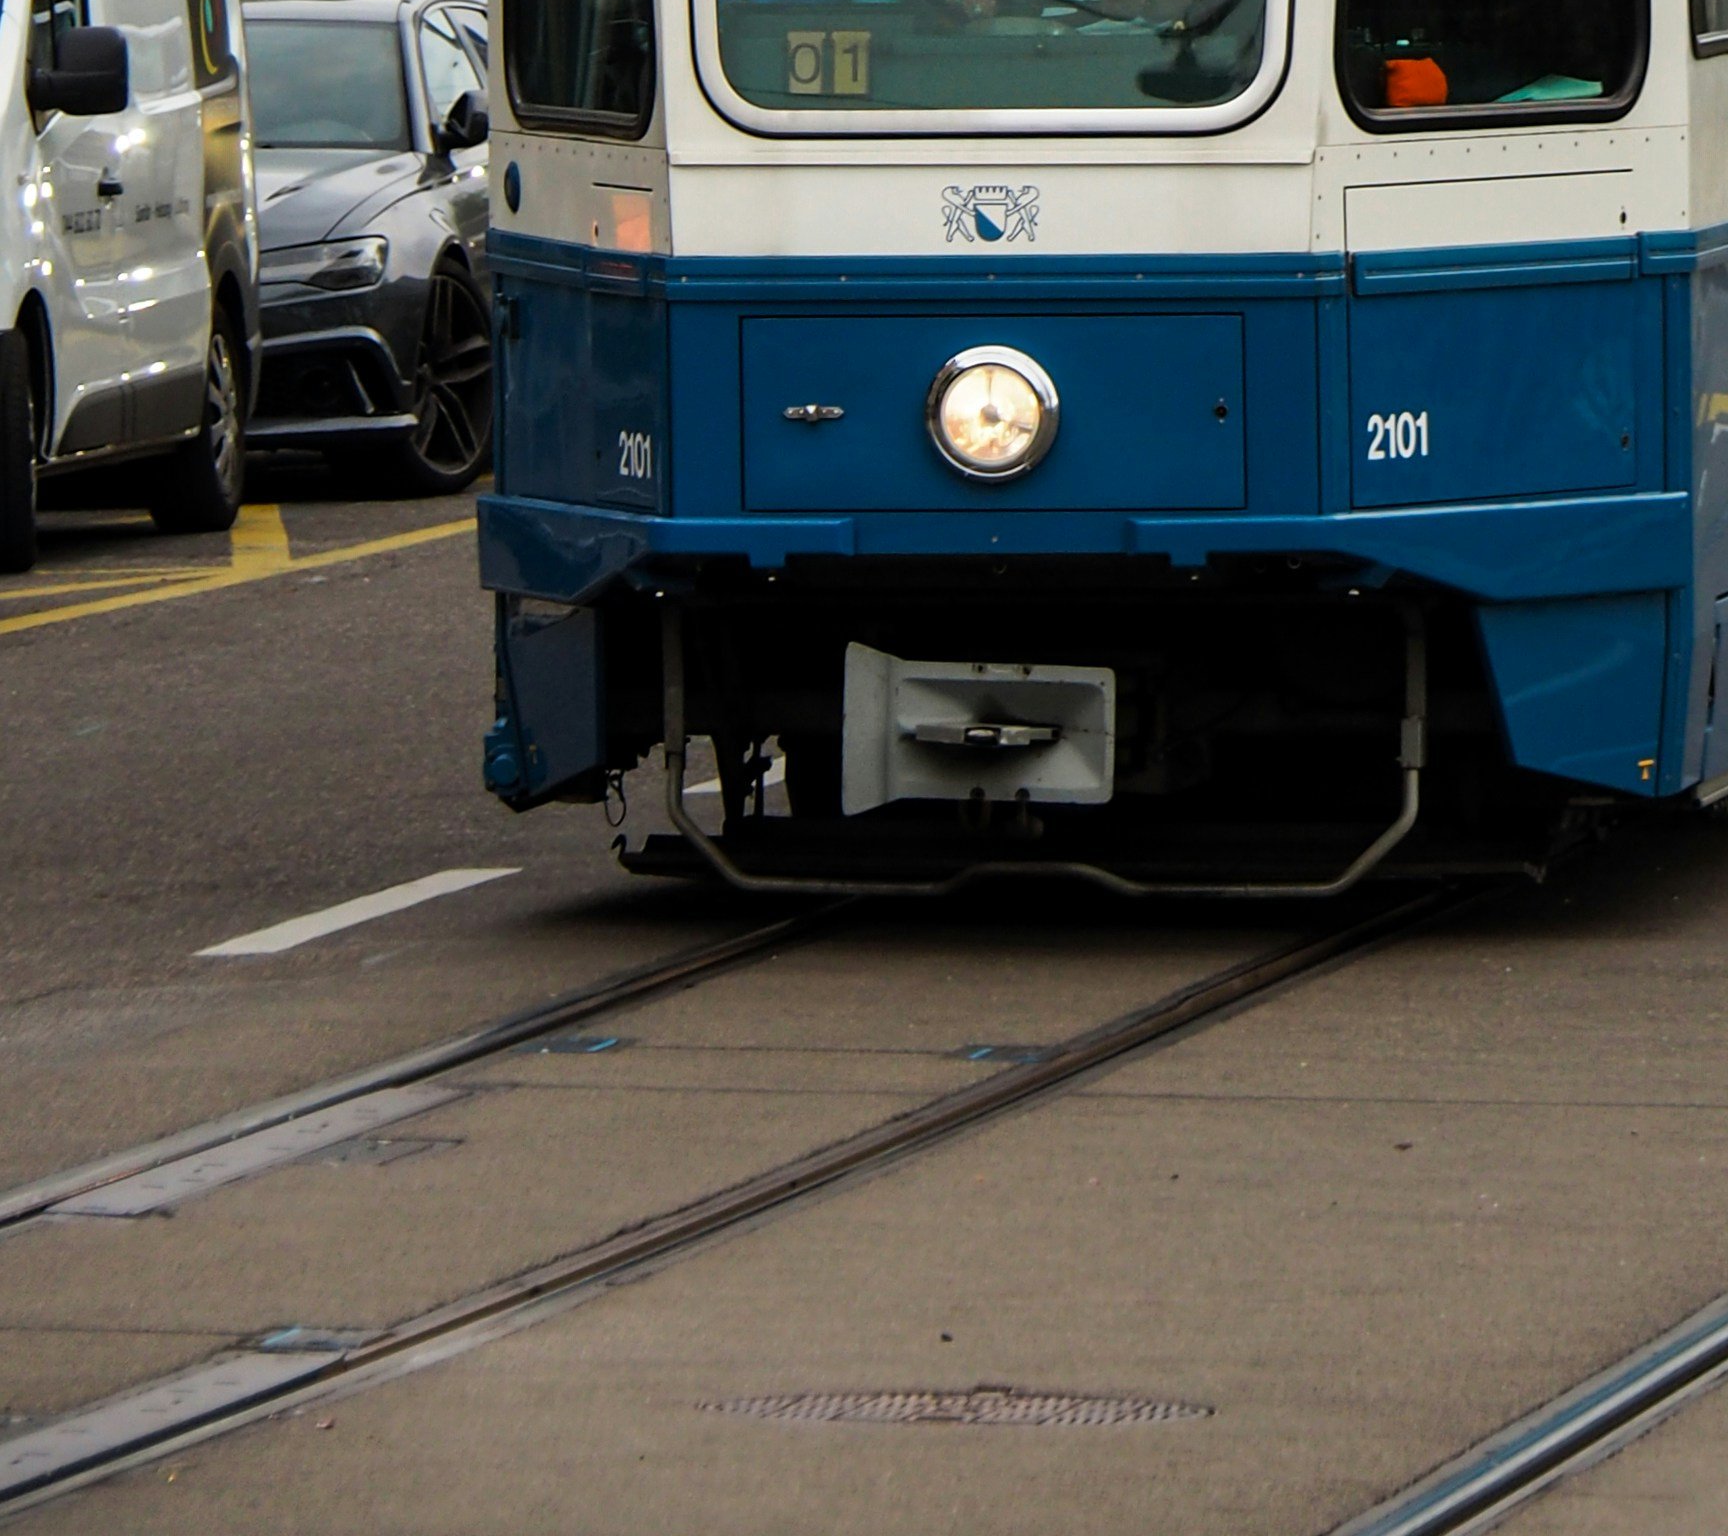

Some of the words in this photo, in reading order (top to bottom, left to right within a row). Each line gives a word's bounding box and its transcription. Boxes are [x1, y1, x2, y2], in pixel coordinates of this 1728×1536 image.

[788, 42, 862, 85] 01
[618, 430, 652, 480] 2101
[1366, 410, 1430, 461] 2101
